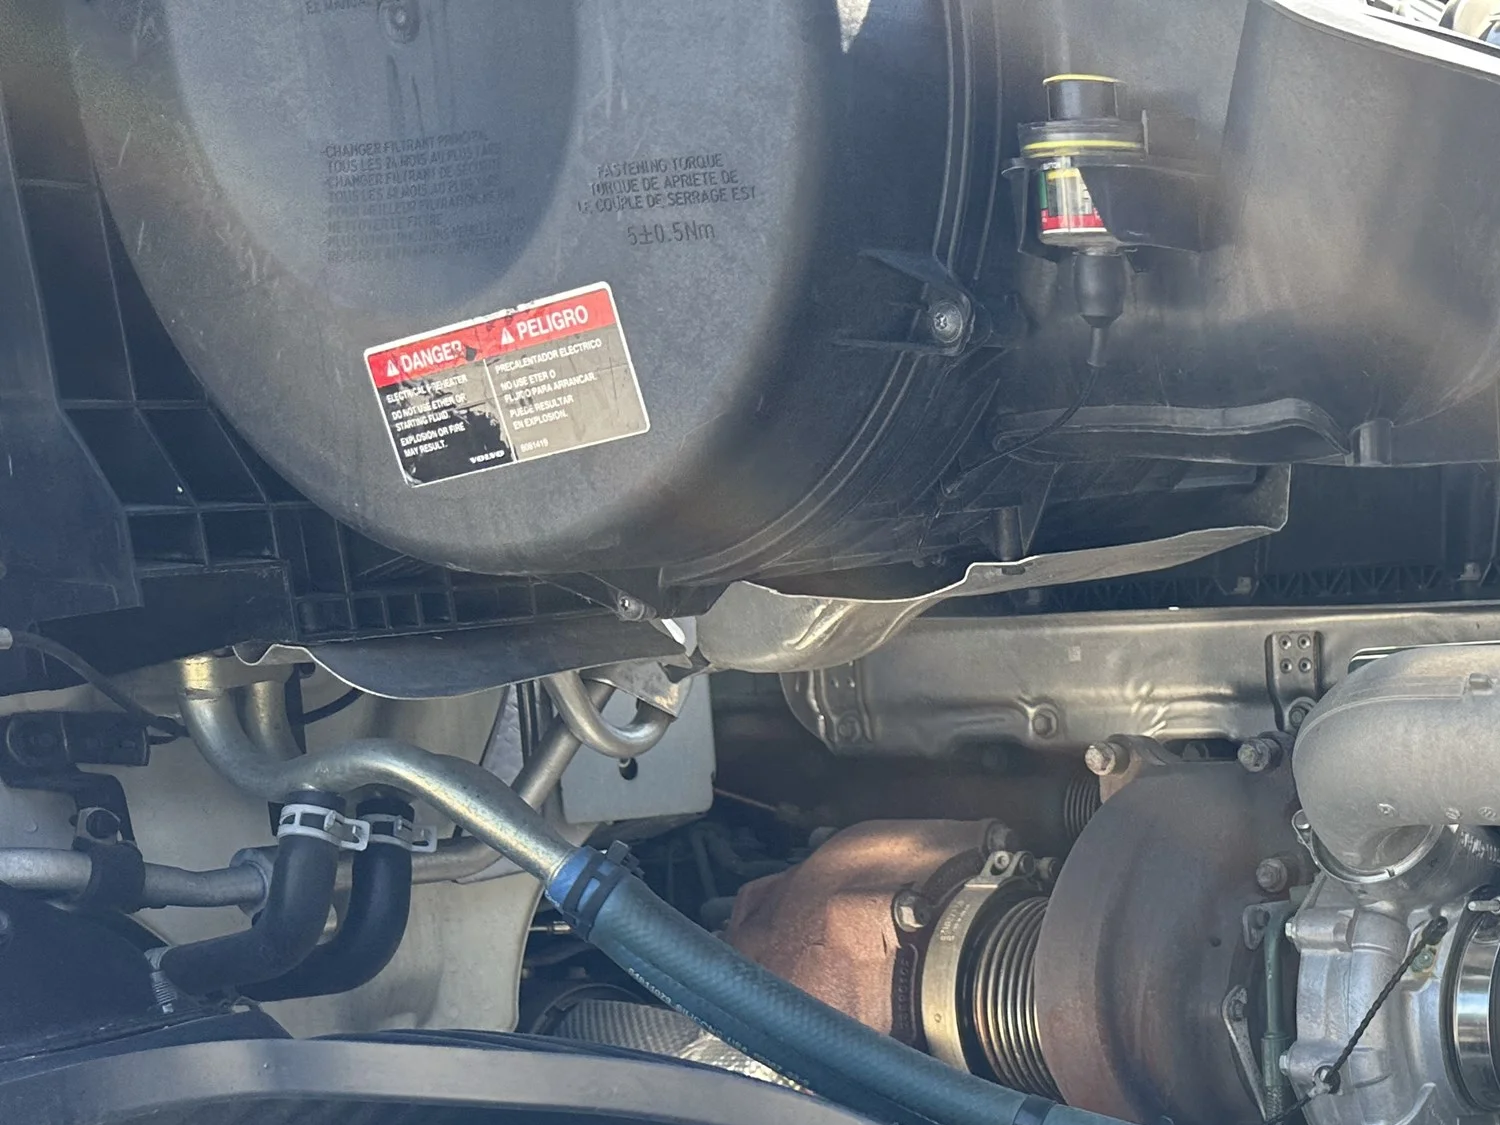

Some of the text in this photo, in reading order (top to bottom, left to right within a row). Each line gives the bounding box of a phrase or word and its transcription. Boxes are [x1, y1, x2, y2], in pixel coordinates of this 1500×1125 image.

[597, 153, 724, 178] FASTENING TORQUE
[591, 169, 739, 197] TORQUE DE APRIETE DE
[595, 194, 644, 212] COUPLE
[647, 193, 664, 209] DE
[667, 187, 728, 207] SERRAGE
[732, 185, 757, 201] EST
[516, 304, 589, 341] PELIGRO
[400, 339, 464, 373] DANGER
[495, 337, 602, 375] PRECALENTADOR ELECTRICO
[500, 370, 557, 392] NO USE ETER O
[531, 383, 553, 397] PARA
[535, 394, 575, 412] RESULTAR
[400, 421, 466, 448] EXPLOSION OR FIRE
[513, 419, 525, 430] EN
[468, 449, 506, 465] VOLVO
